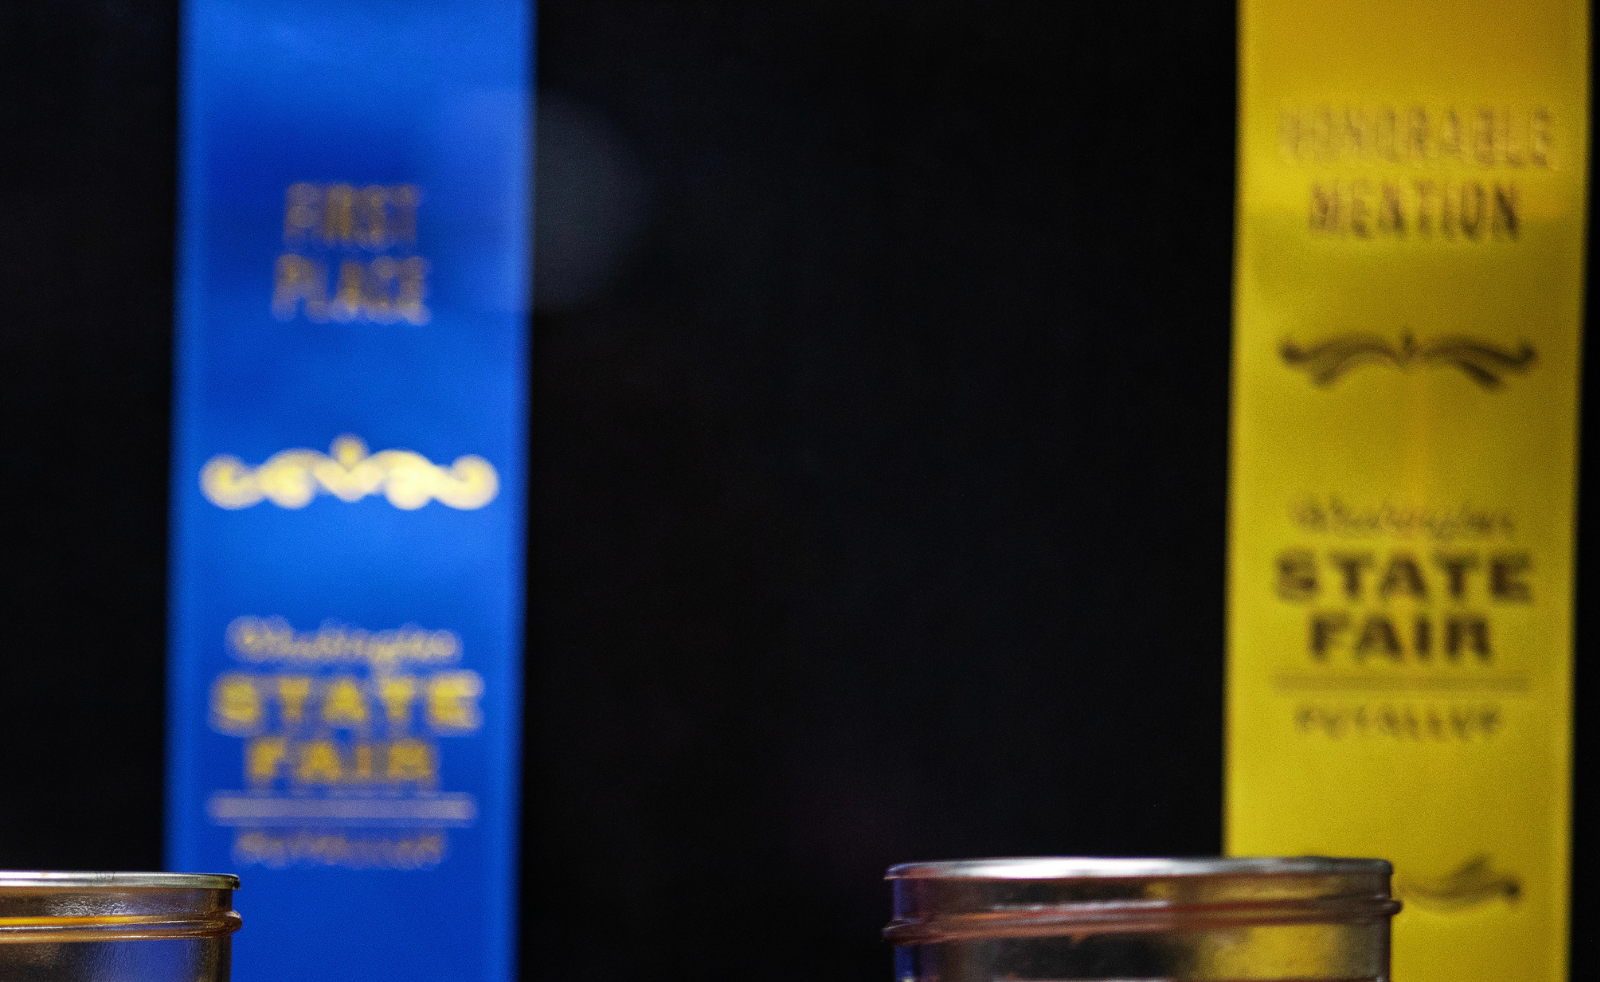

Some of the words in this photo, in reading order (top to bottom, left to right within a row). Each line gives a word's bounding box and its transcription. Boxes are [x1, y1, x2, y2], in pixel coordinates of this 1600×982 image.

[1308, 180, 1520, 240] MENTION
[271, 254, 432, 326] PLACE
[1275, 548, 1533, 605] STATE
[1308, 611, 1493, 662] FAIR
[208, 670, 485, 737] STATE
[245, 738, 441, 789] FAIR
